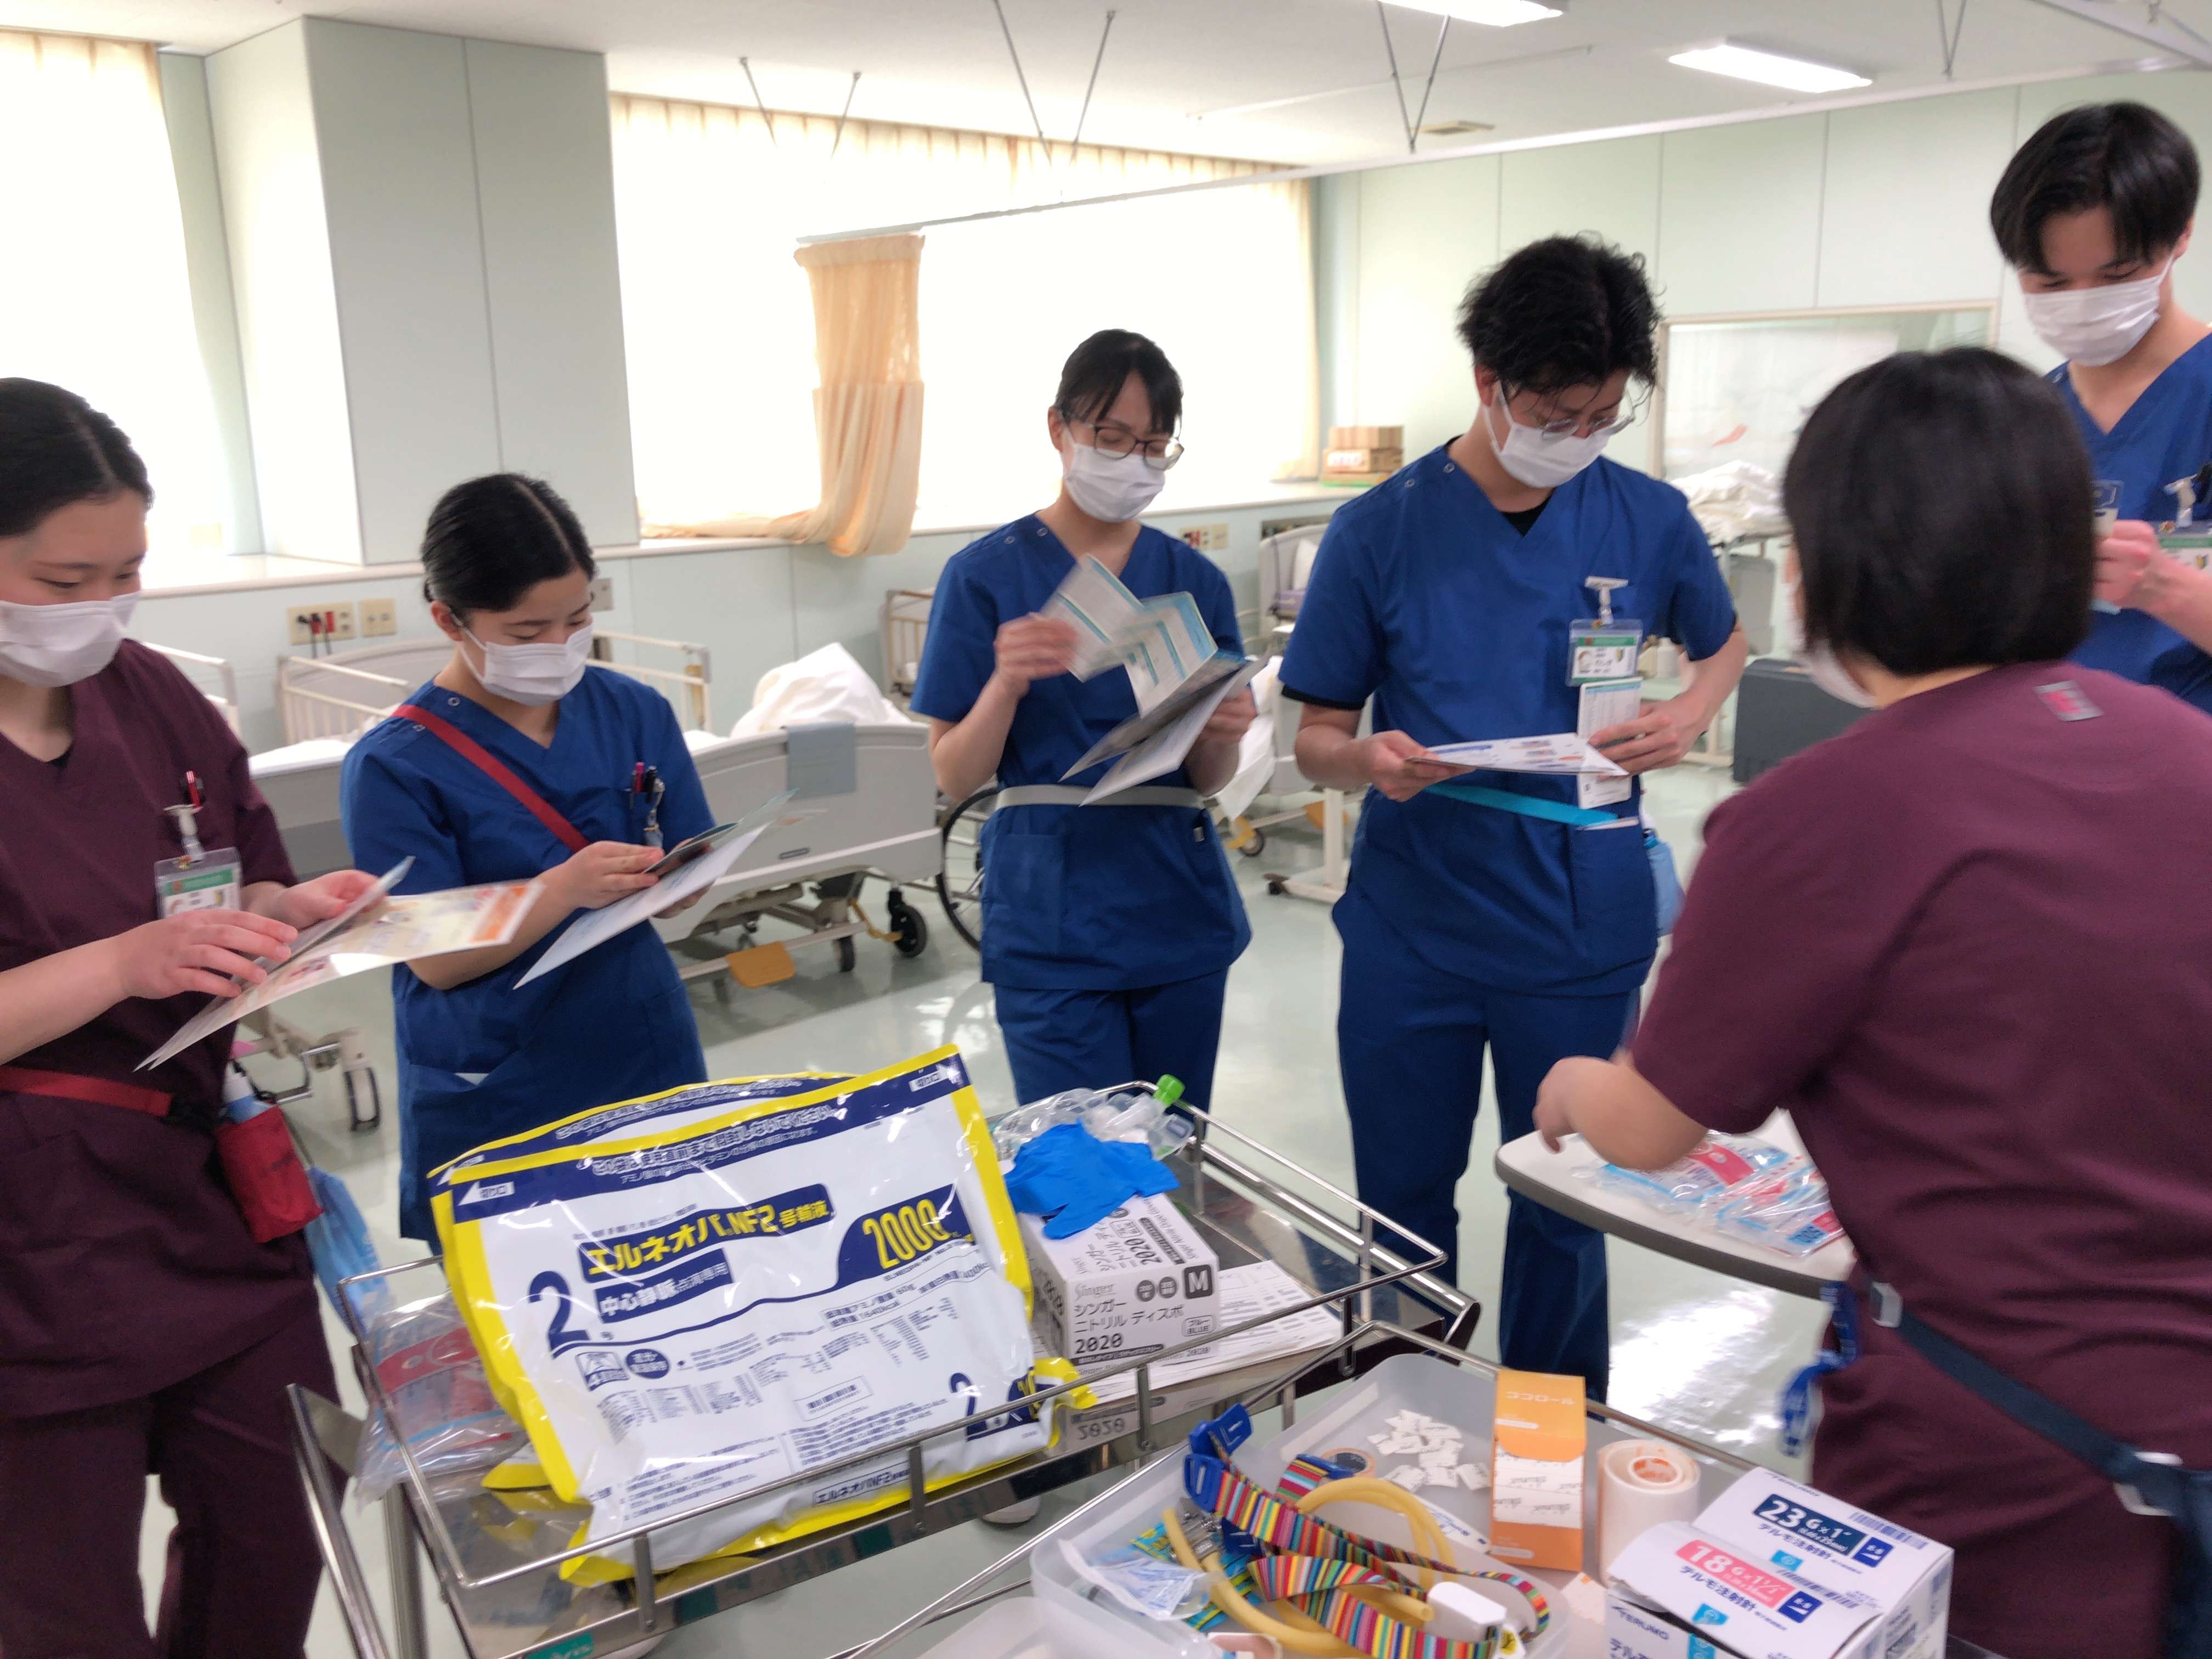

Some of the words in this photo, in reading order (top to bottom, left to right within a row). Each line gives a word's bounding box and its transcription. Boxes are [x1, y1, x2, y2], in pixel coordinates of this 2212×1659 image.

[1125, 1238, 1163, 1266] 2020
[1188, 1270, 1208, 1294] M
[528, 1270, 591, 1352] 2
[1073, 1299, 1127, 1317] シンガー
[1074, 1316, 1128, 1333] ニトリル
[1131, 1304, 1185, 1325] ディスポ
[1074, 1333, 1123, 1355] 2020
[1187, 1325, 1210, 1335] BLUE
[1758, 1499, 1807, 1528] 23
[1689, 1545, 1731, 1573] 18
[1611, 1606, 1669, 1640] TERUMO
